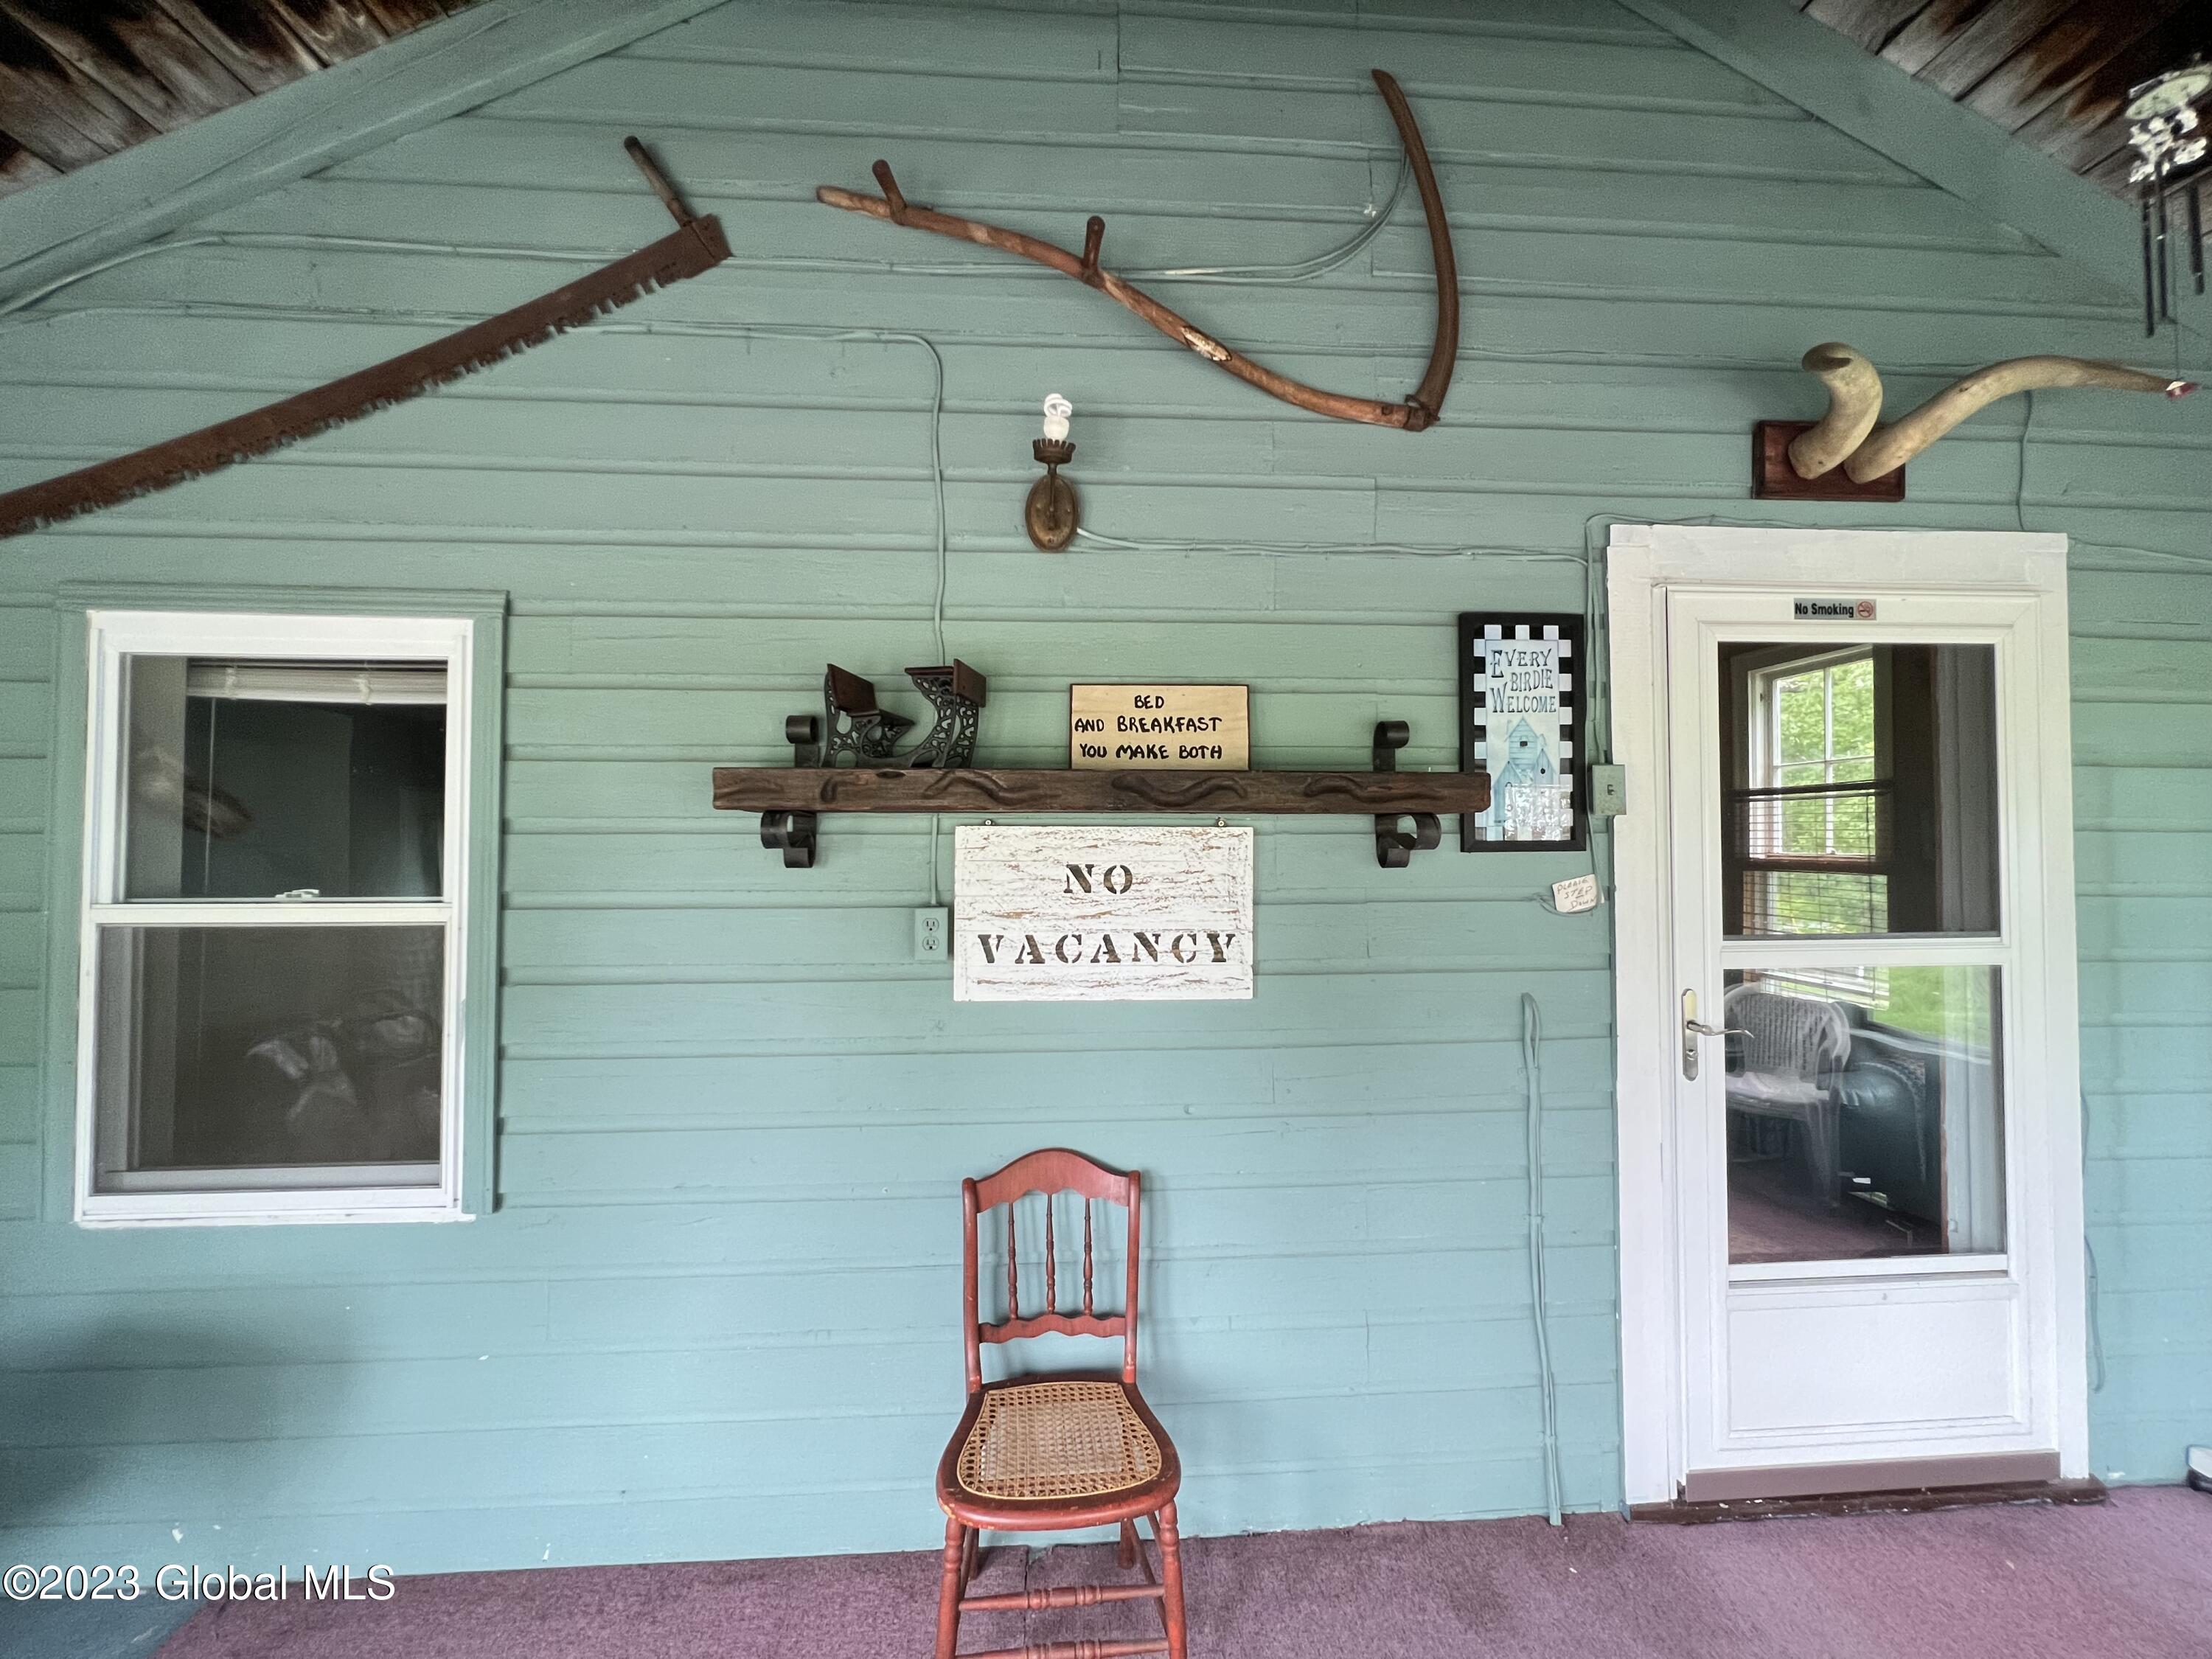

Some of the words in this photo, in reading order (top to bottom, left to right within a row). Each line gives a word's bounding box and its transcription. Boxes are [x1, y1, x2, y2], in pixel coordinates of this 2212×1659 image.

[1795, 602, 1809, 615] No
[1811, 602, 1854, 618] Smoking
[1490, 648, 1552, 678] EVERY
[1510, 669, 1553, 692] BIRDIE
[1134, 695, 1165, 709] BED
[1490, 682, 1557, 712] WELCOME
[1074, 717, 1105, 733] AND
[1117, 715, 1222, 734] BREAKFAST
[1079, 743, 1107, 759] YOU
[1116, 744, 1169, 760] MAKE
[1179, 745, 1222, 759] BOTH
[1063, 863, 1133, 894] NO
[978, 932, 1236, 964] VACANCY
